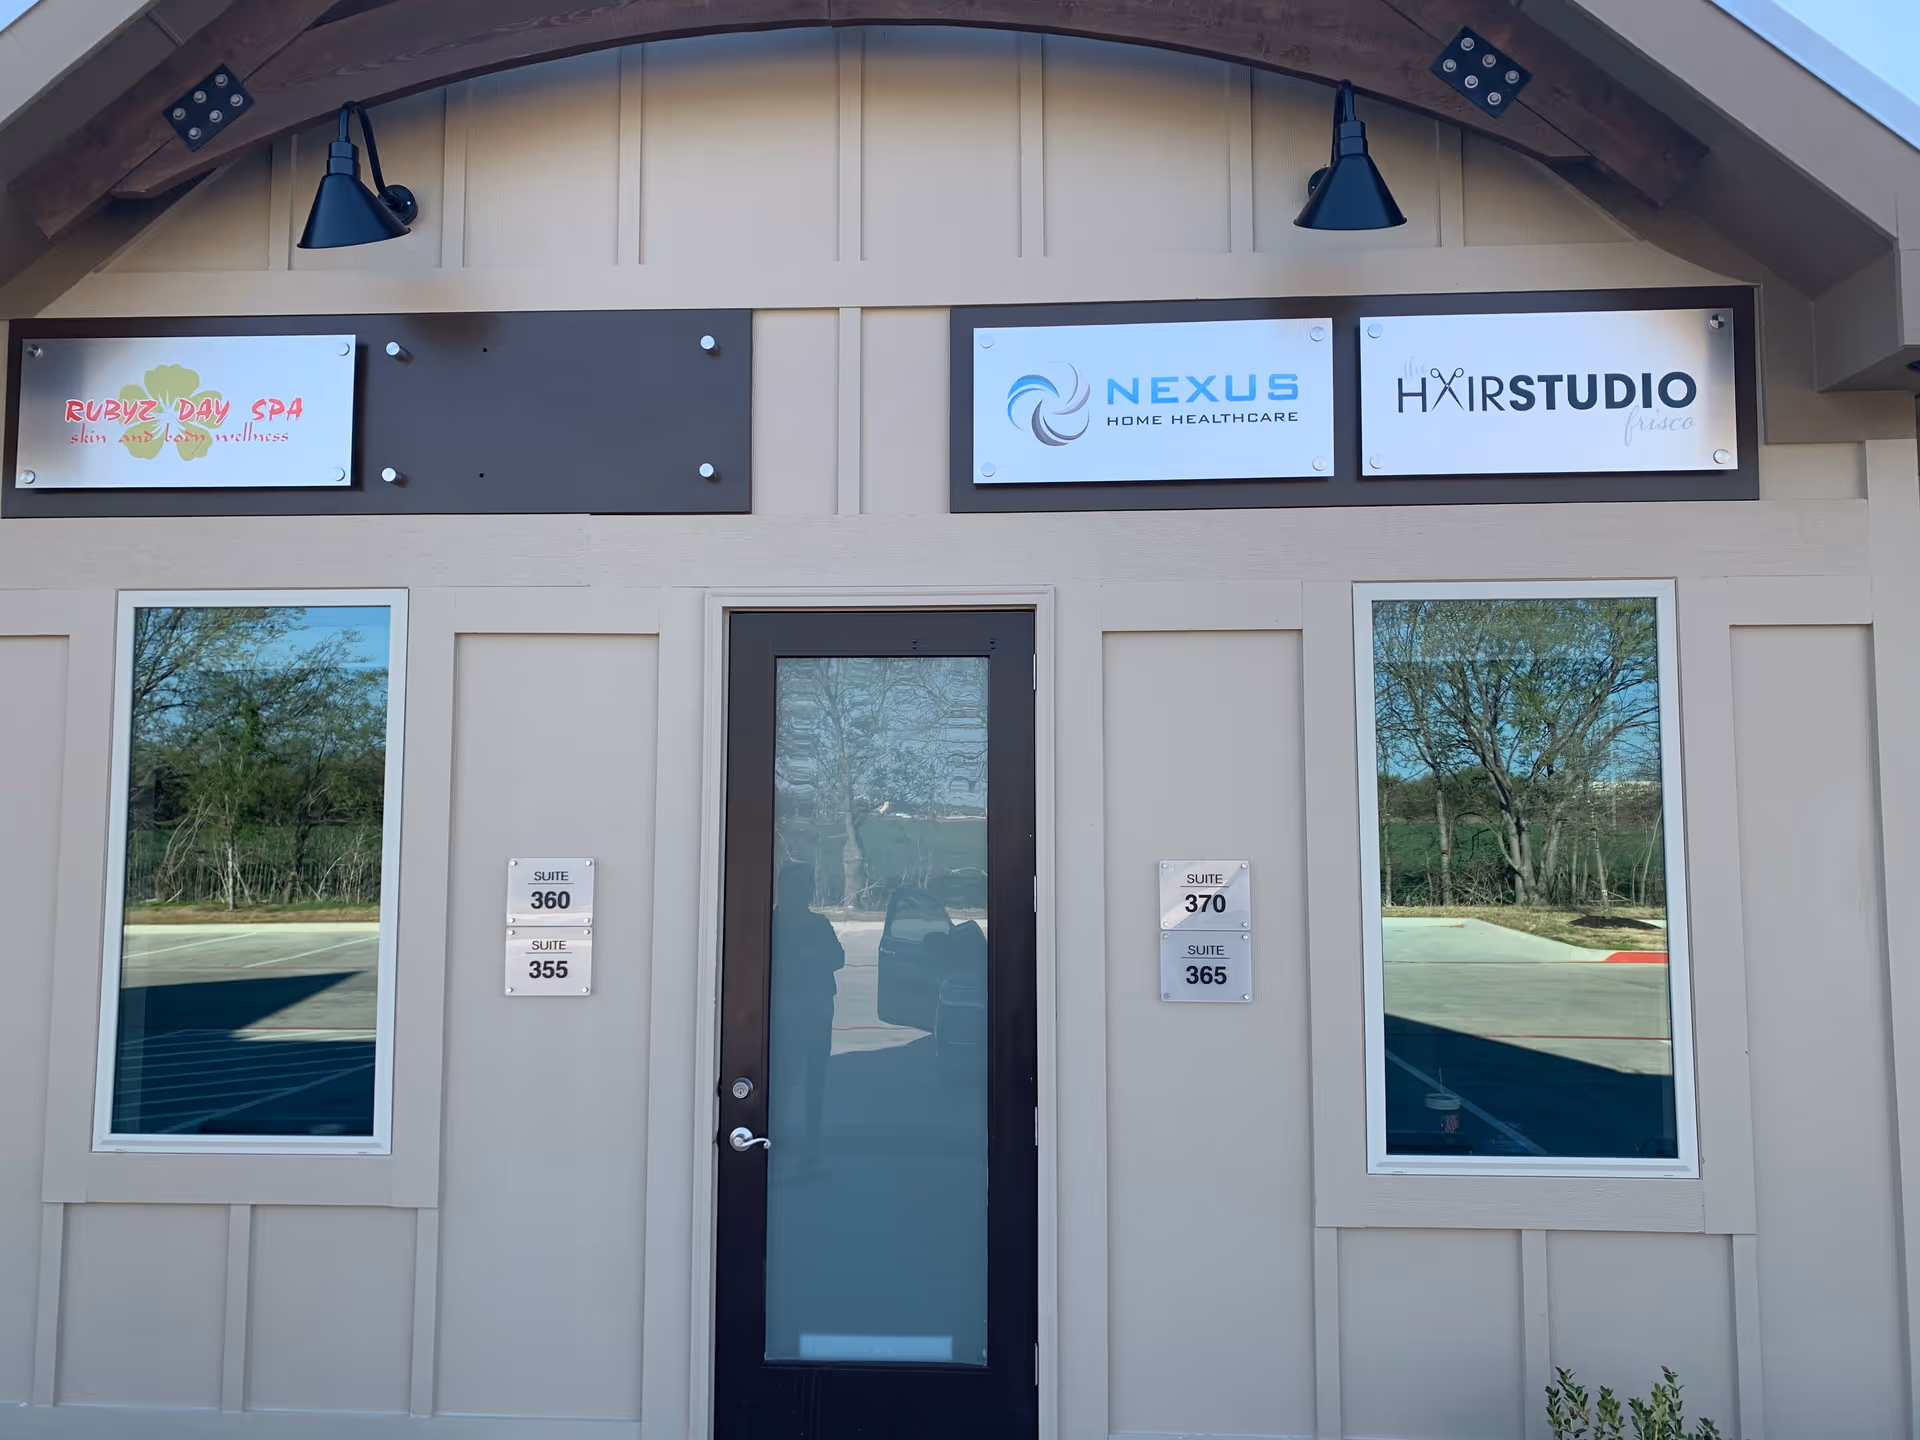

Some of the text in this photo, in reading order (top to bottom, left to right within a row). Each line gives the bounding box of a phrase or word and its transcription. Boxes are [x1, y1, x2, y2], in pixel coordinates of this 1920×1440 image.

[1107, 373, 1299, 405] NEXUS
[64, 397, 304, 425] RUBYZ DAY SPA
[1107, 411, 1299, 426] HOME HEALTHCARE
[1624, 405, 1695, 446] frisco
[70, 422, 289, 457] skin and body wellness
[533, 871, 569, 881] SUITE
[1186, 874, 1223, 884] SUITE
[530, 891, 571, 909] 360
[1185, 894, 1226, 913] 370
[531, 940, 567, 950] SUITE
[1187, 945, 1225, 955] SUITE
[528, 960, 568, 979] 355
[1186, 965, 1227, 985] 365
